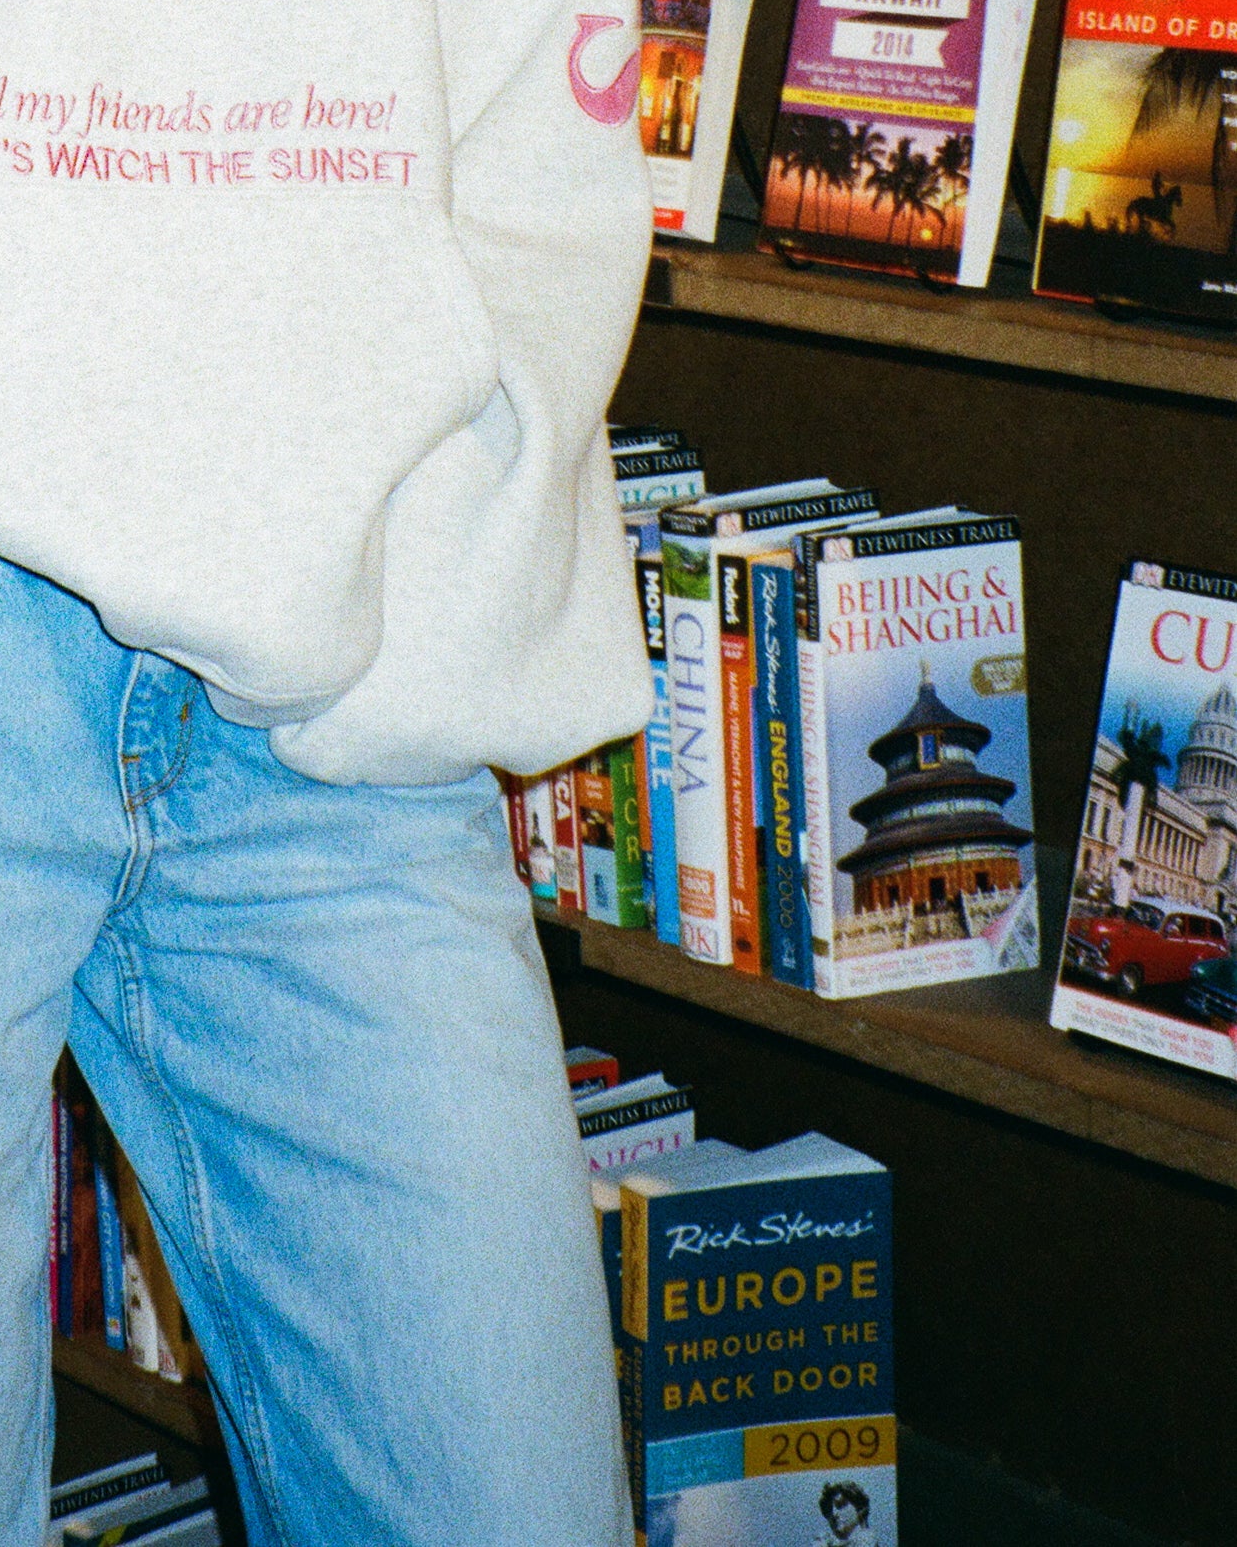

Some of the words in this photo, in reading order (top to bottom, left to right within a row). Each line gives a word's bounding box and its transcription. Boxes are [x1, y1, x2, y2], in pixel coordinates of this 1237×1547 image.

[1077, 10, 1158, 36] ISLAND
[1166, 16, 1200, 38] OF
[1208, 20, 1237, 41] DR
[15, 90, 78, 136] my
[75, 81, 214, 140] friends
[224, 96, 294, 134] are
[302, 82, 398, 133] here!
[45, 140, 172, 184] WATCH
[178, 149, 257, 185] THE
[267, 145, 419, 187] SUNSET
[746, 500, 828, 531] EYEWITNESS
[829, 490, 877, 516] TRAVEL
[855, 528, 955, 558] EYEWITNESS
[960, 519, 1018, 543] TRAVEL
[644, 569, 664, 650] MOON
[758, 571, 780, 629] Rick
[836, 568, 973, 618] BEIJING
[981, 565, 1009, 601] &
[1168, 569, 1237, 599] EYEWIT
[826, 600, 1021, 657] SHANGHAI
[1150, 609, 1237, 674] CU
[671, 611, 710, 795] CHINA
[768, 719, 794, 859] ENGLAND
[776, 864, 795, 929] 2006
[581, 1107, 641, 1134] WITNESS
[665, 1220, 752, 1260] Rick
[663, 1259, 880, 1323] EUROPE
[663, 1331, 807, 1367] THROUGH
[823, 1321, 880, 1346] THE
[663, 1372, 756, 1413] BACK
[773, 1362, 879, 1397] DOOR
[768, 1424, 882, 1467] 2009
